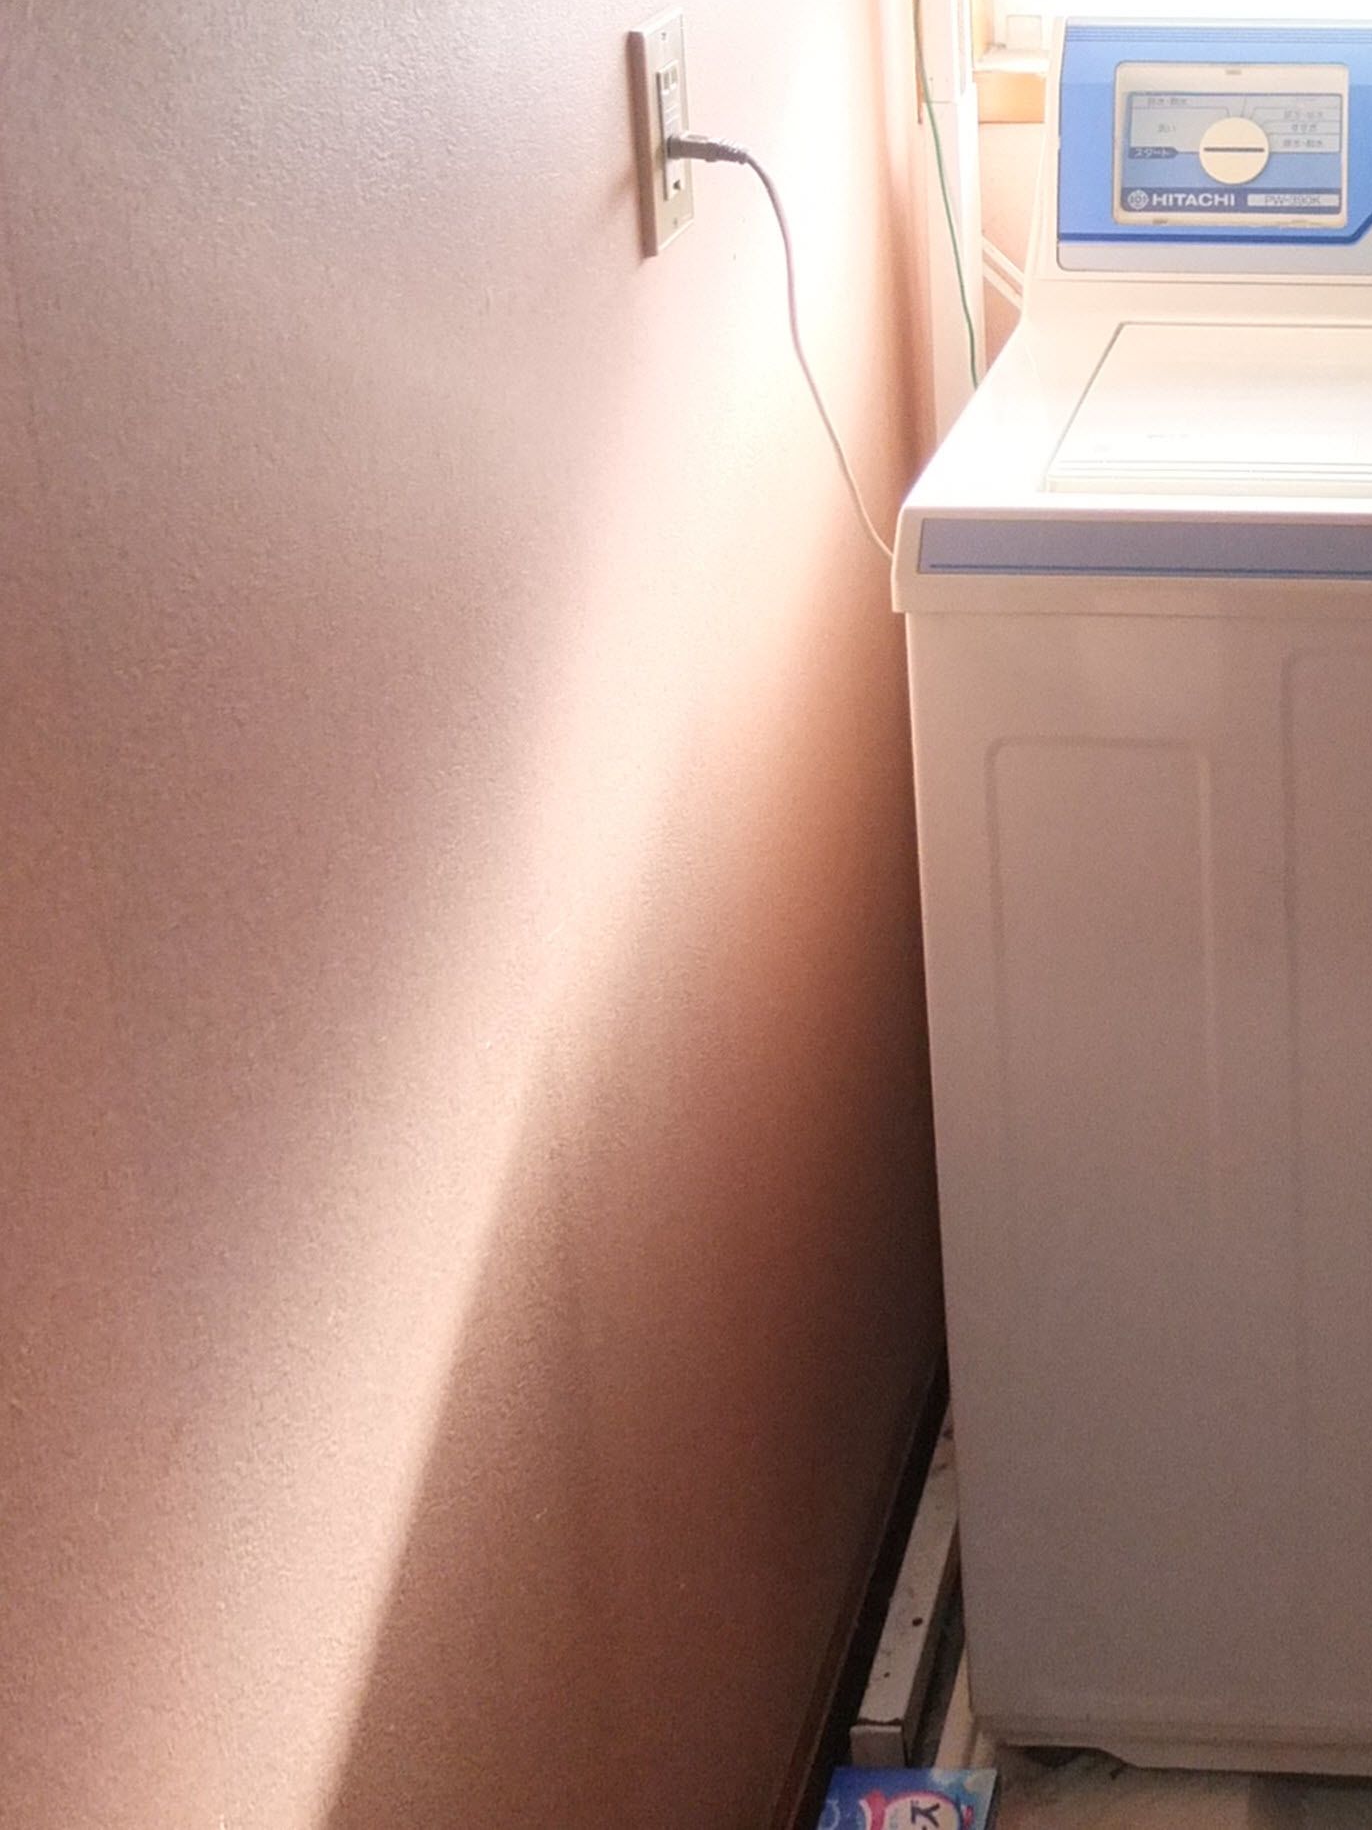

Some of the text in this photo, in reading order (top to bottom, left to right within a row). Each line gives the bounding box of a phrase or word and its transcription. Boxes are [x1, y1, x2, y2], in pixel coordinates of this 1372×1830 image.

[1135, 147, 1172, 159] スタート
[1152, 192, 1236, 207] HITACHI
